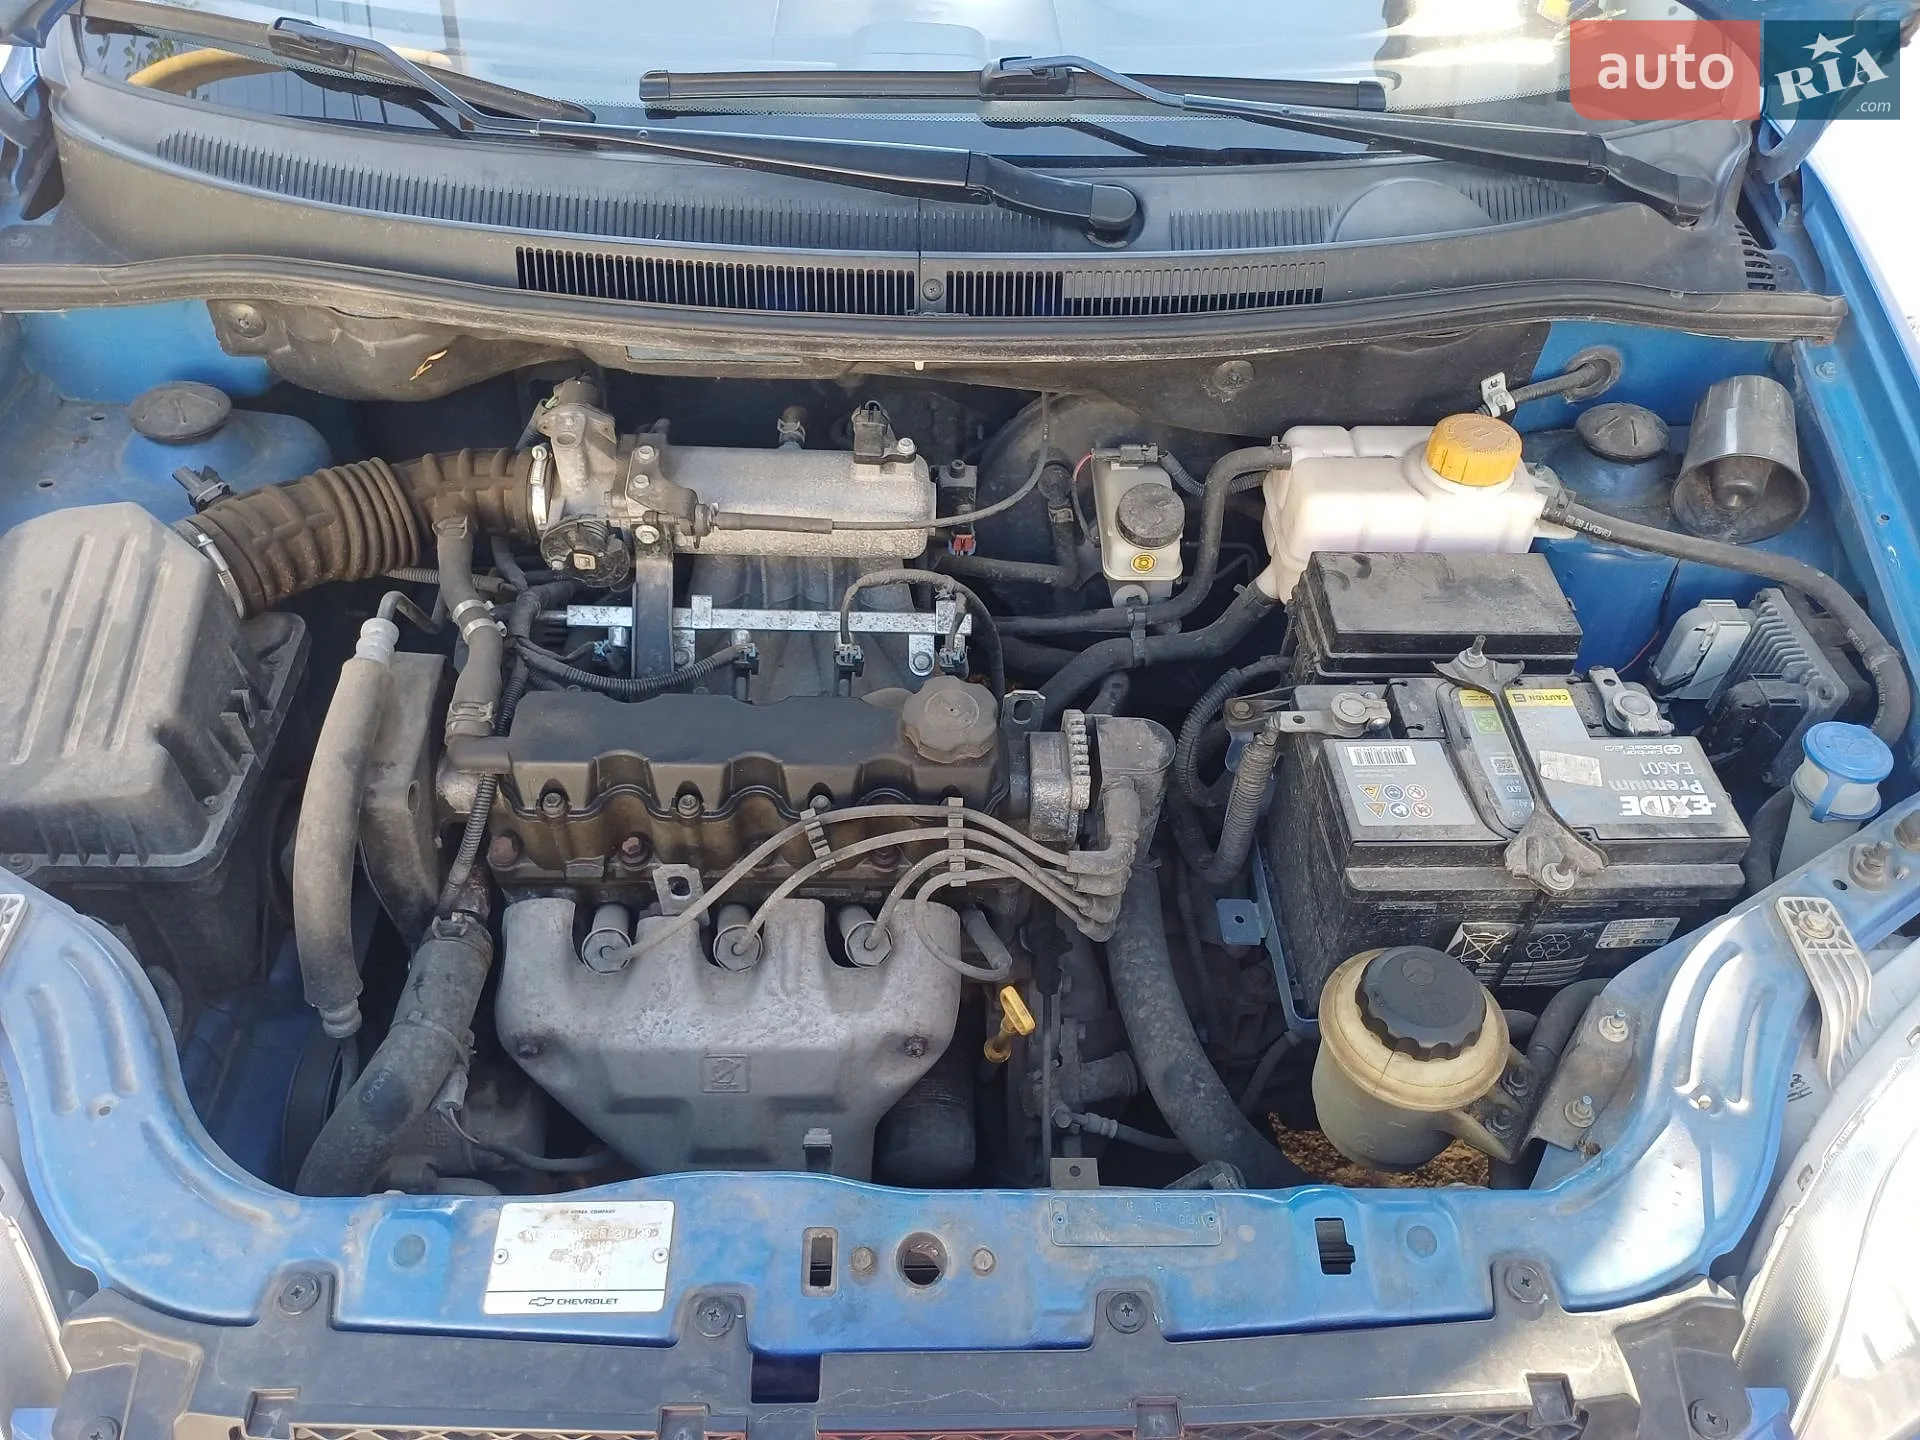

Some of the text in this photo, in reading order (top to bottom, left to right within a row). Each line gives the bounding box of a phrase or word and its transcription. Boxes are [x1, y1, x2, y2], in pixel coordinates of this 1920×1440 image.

[1528, 693, 1569, 701] CAUTION
[1639, 761, 1695, 775] EA601
[1608, 779, 1705, 794] Premium
[1619, 794, 1717, 819] EXIDE
